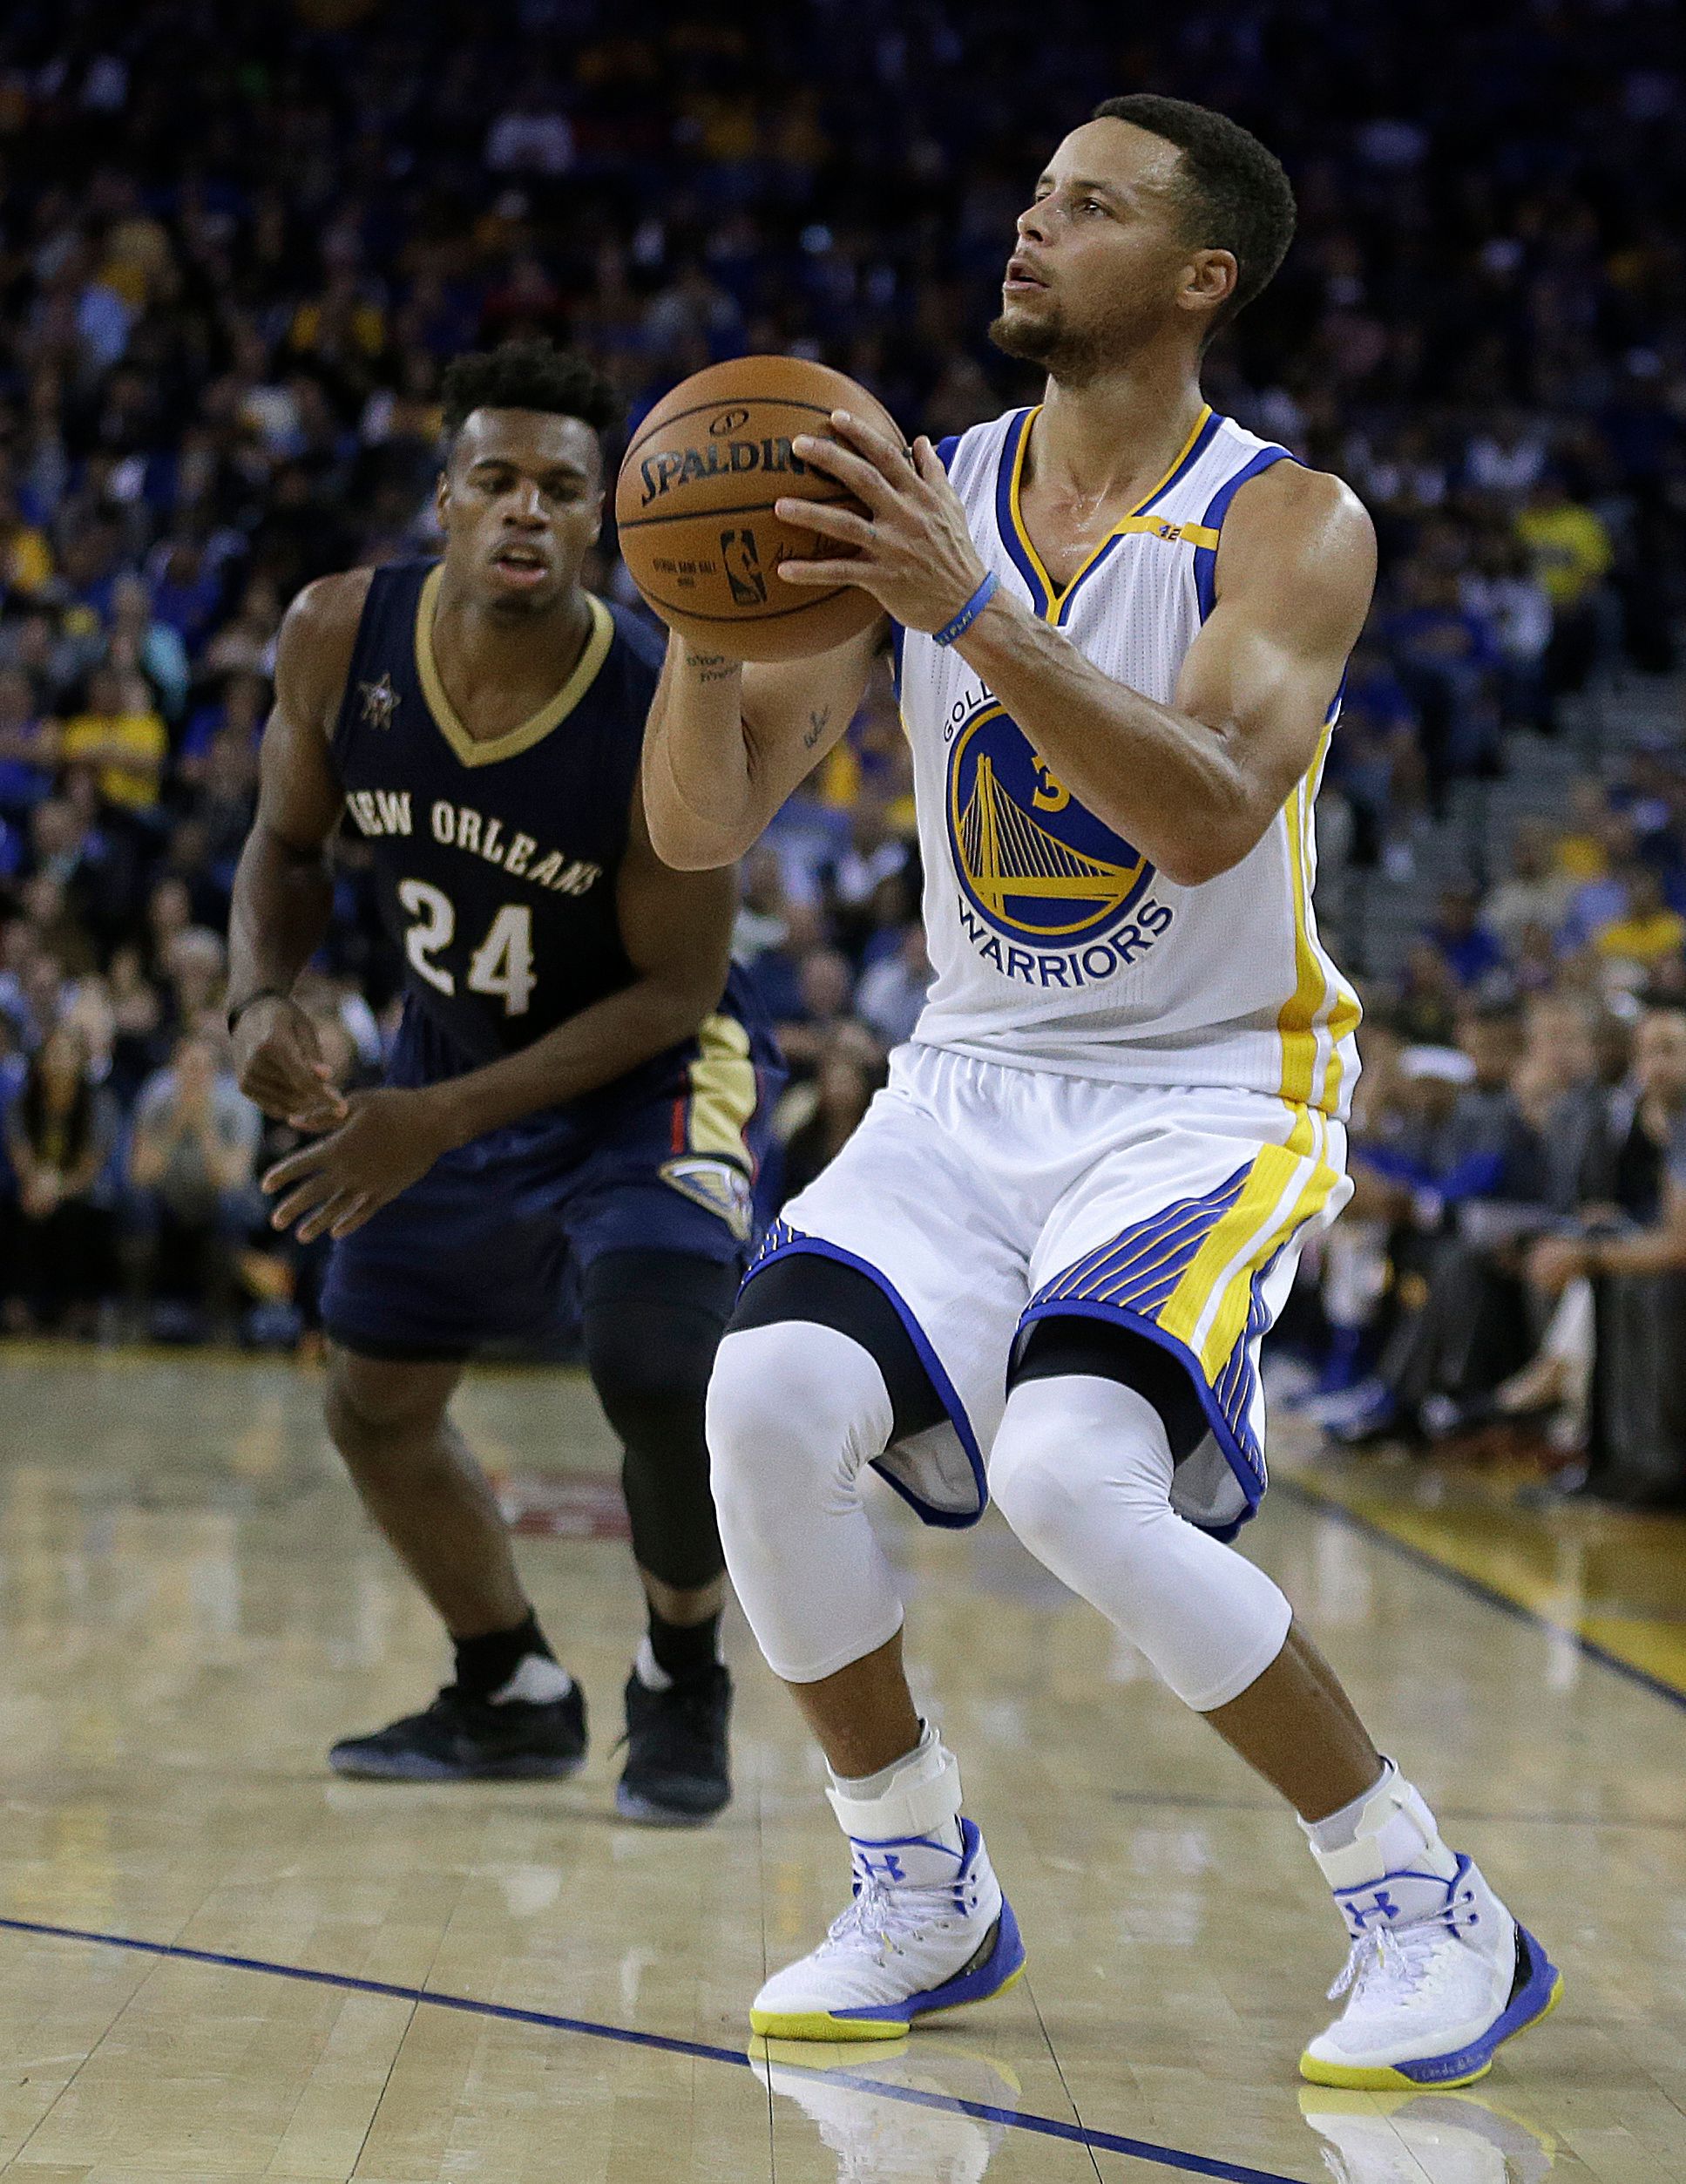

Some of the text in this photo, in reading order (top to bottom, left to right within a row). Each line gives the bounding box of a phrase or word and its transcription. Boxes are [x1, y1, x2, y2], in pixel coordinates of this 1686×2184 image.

[641, 435, 832, 507] SPALDIN
[396, 877, 538, 1017] 24
[958, 897, 1175, 989] WARRIORS
